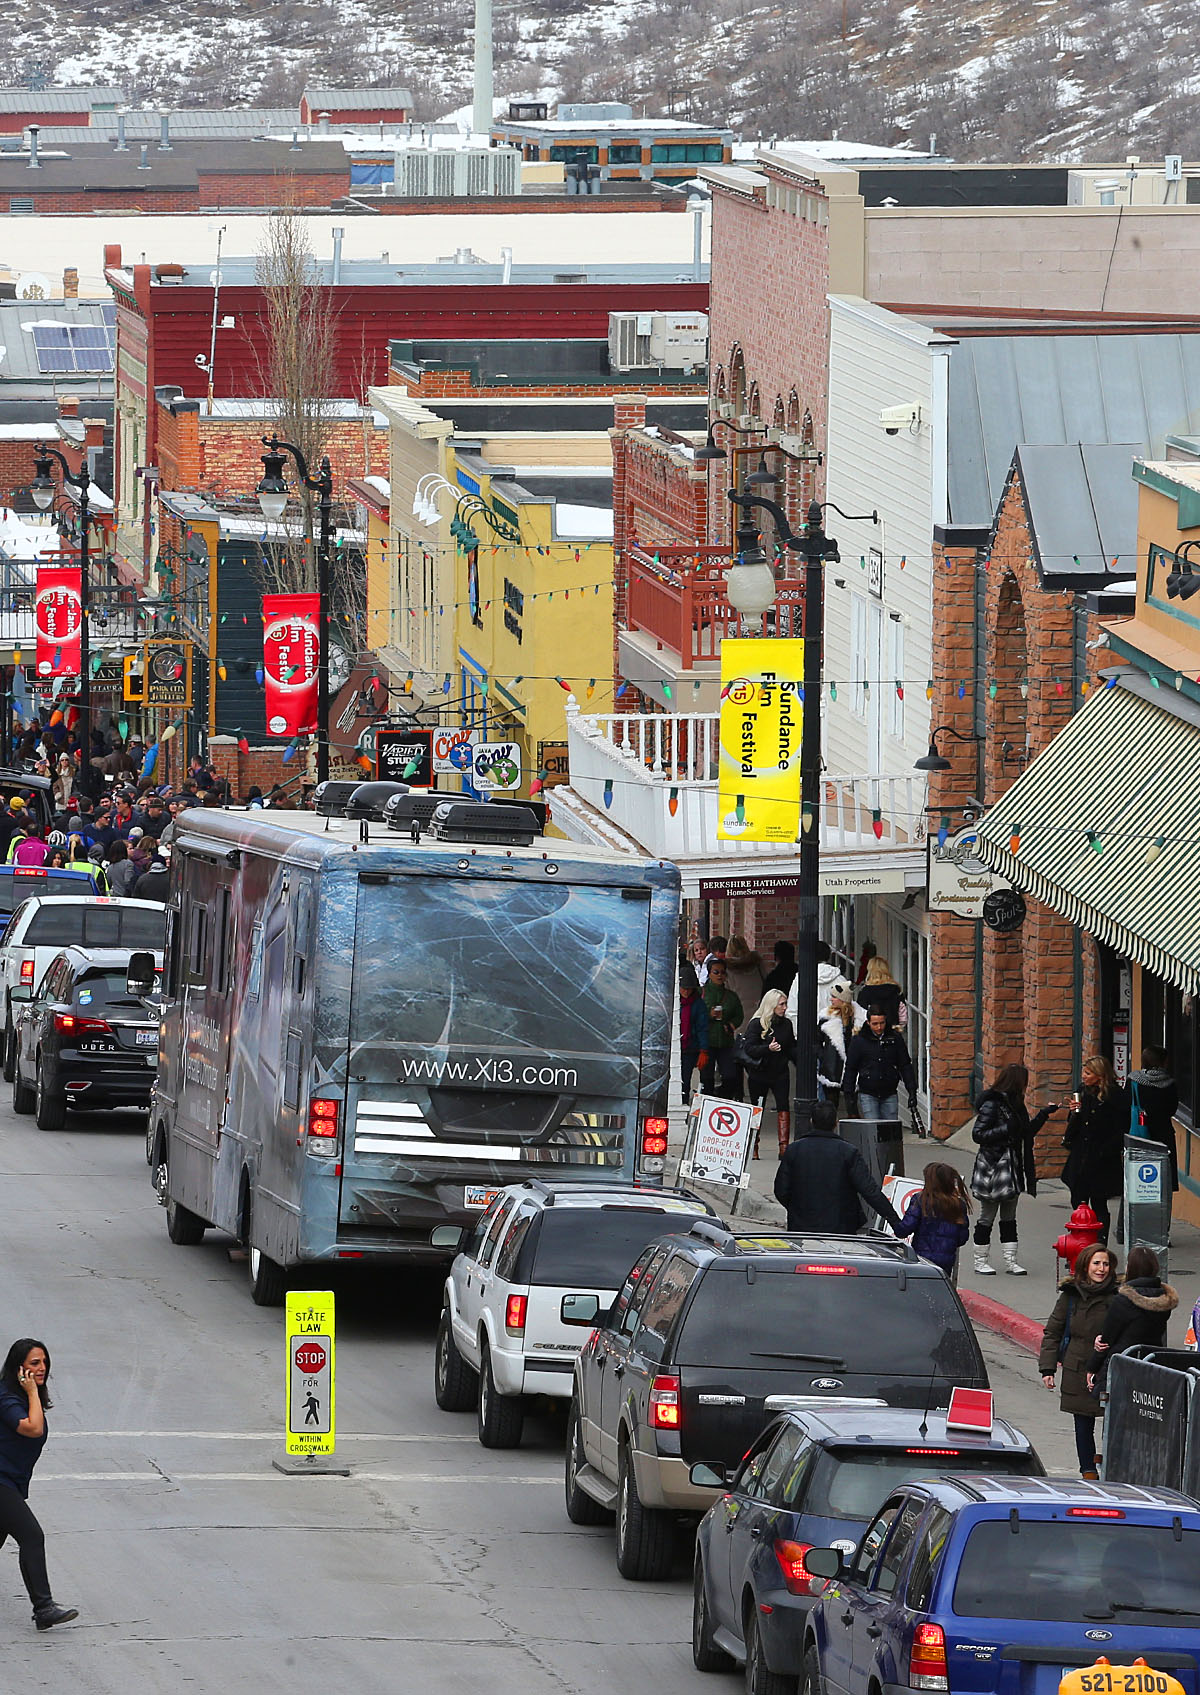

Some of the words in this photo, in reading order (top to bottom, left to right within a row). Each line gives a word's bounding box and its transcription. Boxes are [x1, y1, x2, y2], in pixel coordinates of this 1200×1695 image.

[778, 682, 795, 770] Sundance
[382, 743, 427, 757] VARIETY
[741, 712, 757, 778] Festival
[387, 757, 422, 765] STUD
[703, 880, 752, 889] BERKSHIRE
[753, 878, 799, 888] HATHAWAY
[825, 878, 843, 887] Utah
[844, 877, 881, 887] Properties
[727, 888, 775, 896] HomeServices
[81, 1043, 115, 1051] UBER
[402, 1057, 578, 1087] www.Xi3.com
[703, 1135, 734, 1148] DROP-OFF
[734, 1141, 741, 1150] &
[698, 1145, 724, 1157] LOADING
[725, 1150, 743, 1160] ONLY
[720, 1158, 733, 1167] FINE
[295, 1313, 326, 1322] STATE
[300, 1324, 321, 1333] LAW
[543, 1343, 582, 1351] BLAZER
[296, 1352, 325, 1364] STOP
[302, 1379, 319, 1387] FOR
[1132, 1390, 1164, 1410] SUNDANCE
[290, 1444, 330, 1452] CROSSWALK
[1080, 1673, 1168, 1693] 521-2100
